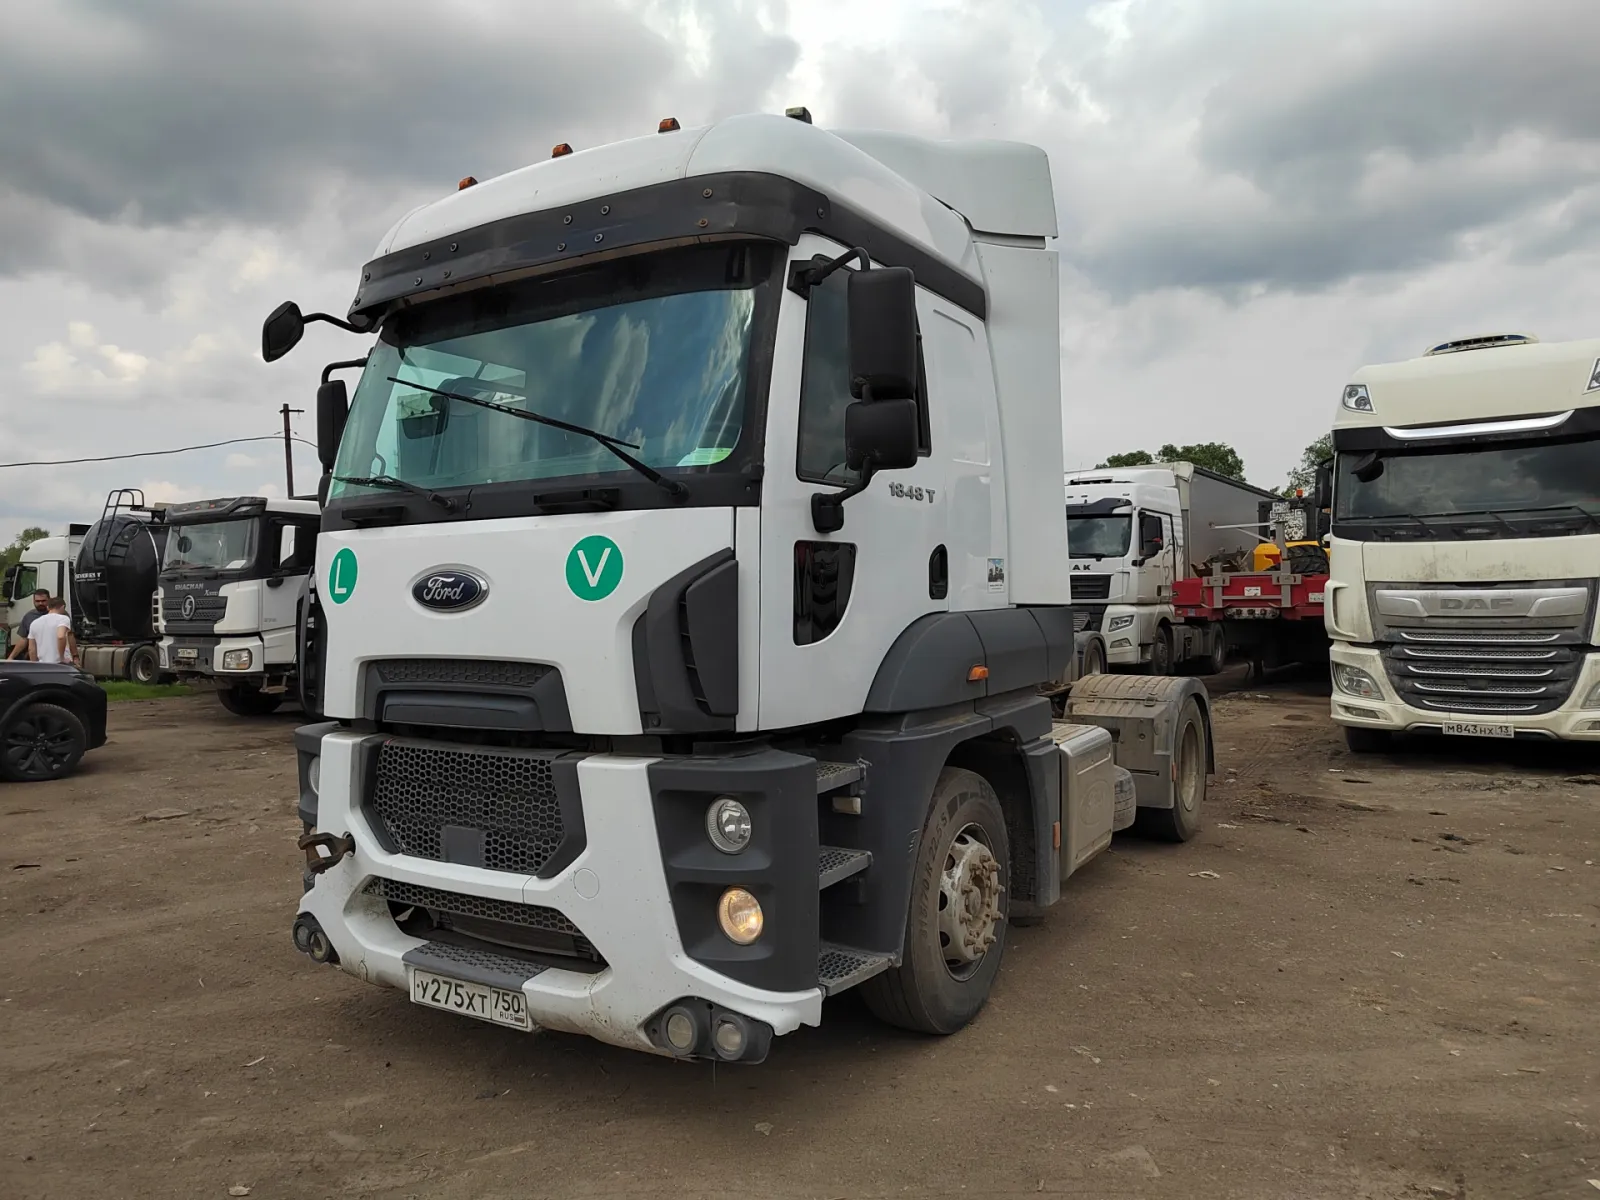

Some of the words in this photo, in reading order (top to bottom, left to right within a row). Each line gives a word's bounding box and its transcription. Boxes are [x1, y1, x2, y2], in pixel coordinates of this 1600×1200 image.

[889, 481, 924, 502] 1848
[925, 488, 936, 504] T
[334, 558, 346, 594] L
[577, 547, 612, 587] V
[423, 575, 464, 601] Ford
[1440, 598, 1514, 610] DAF
[492, 989, 521, 1014] 750
[499, 1011, 514, 1021] RUS
